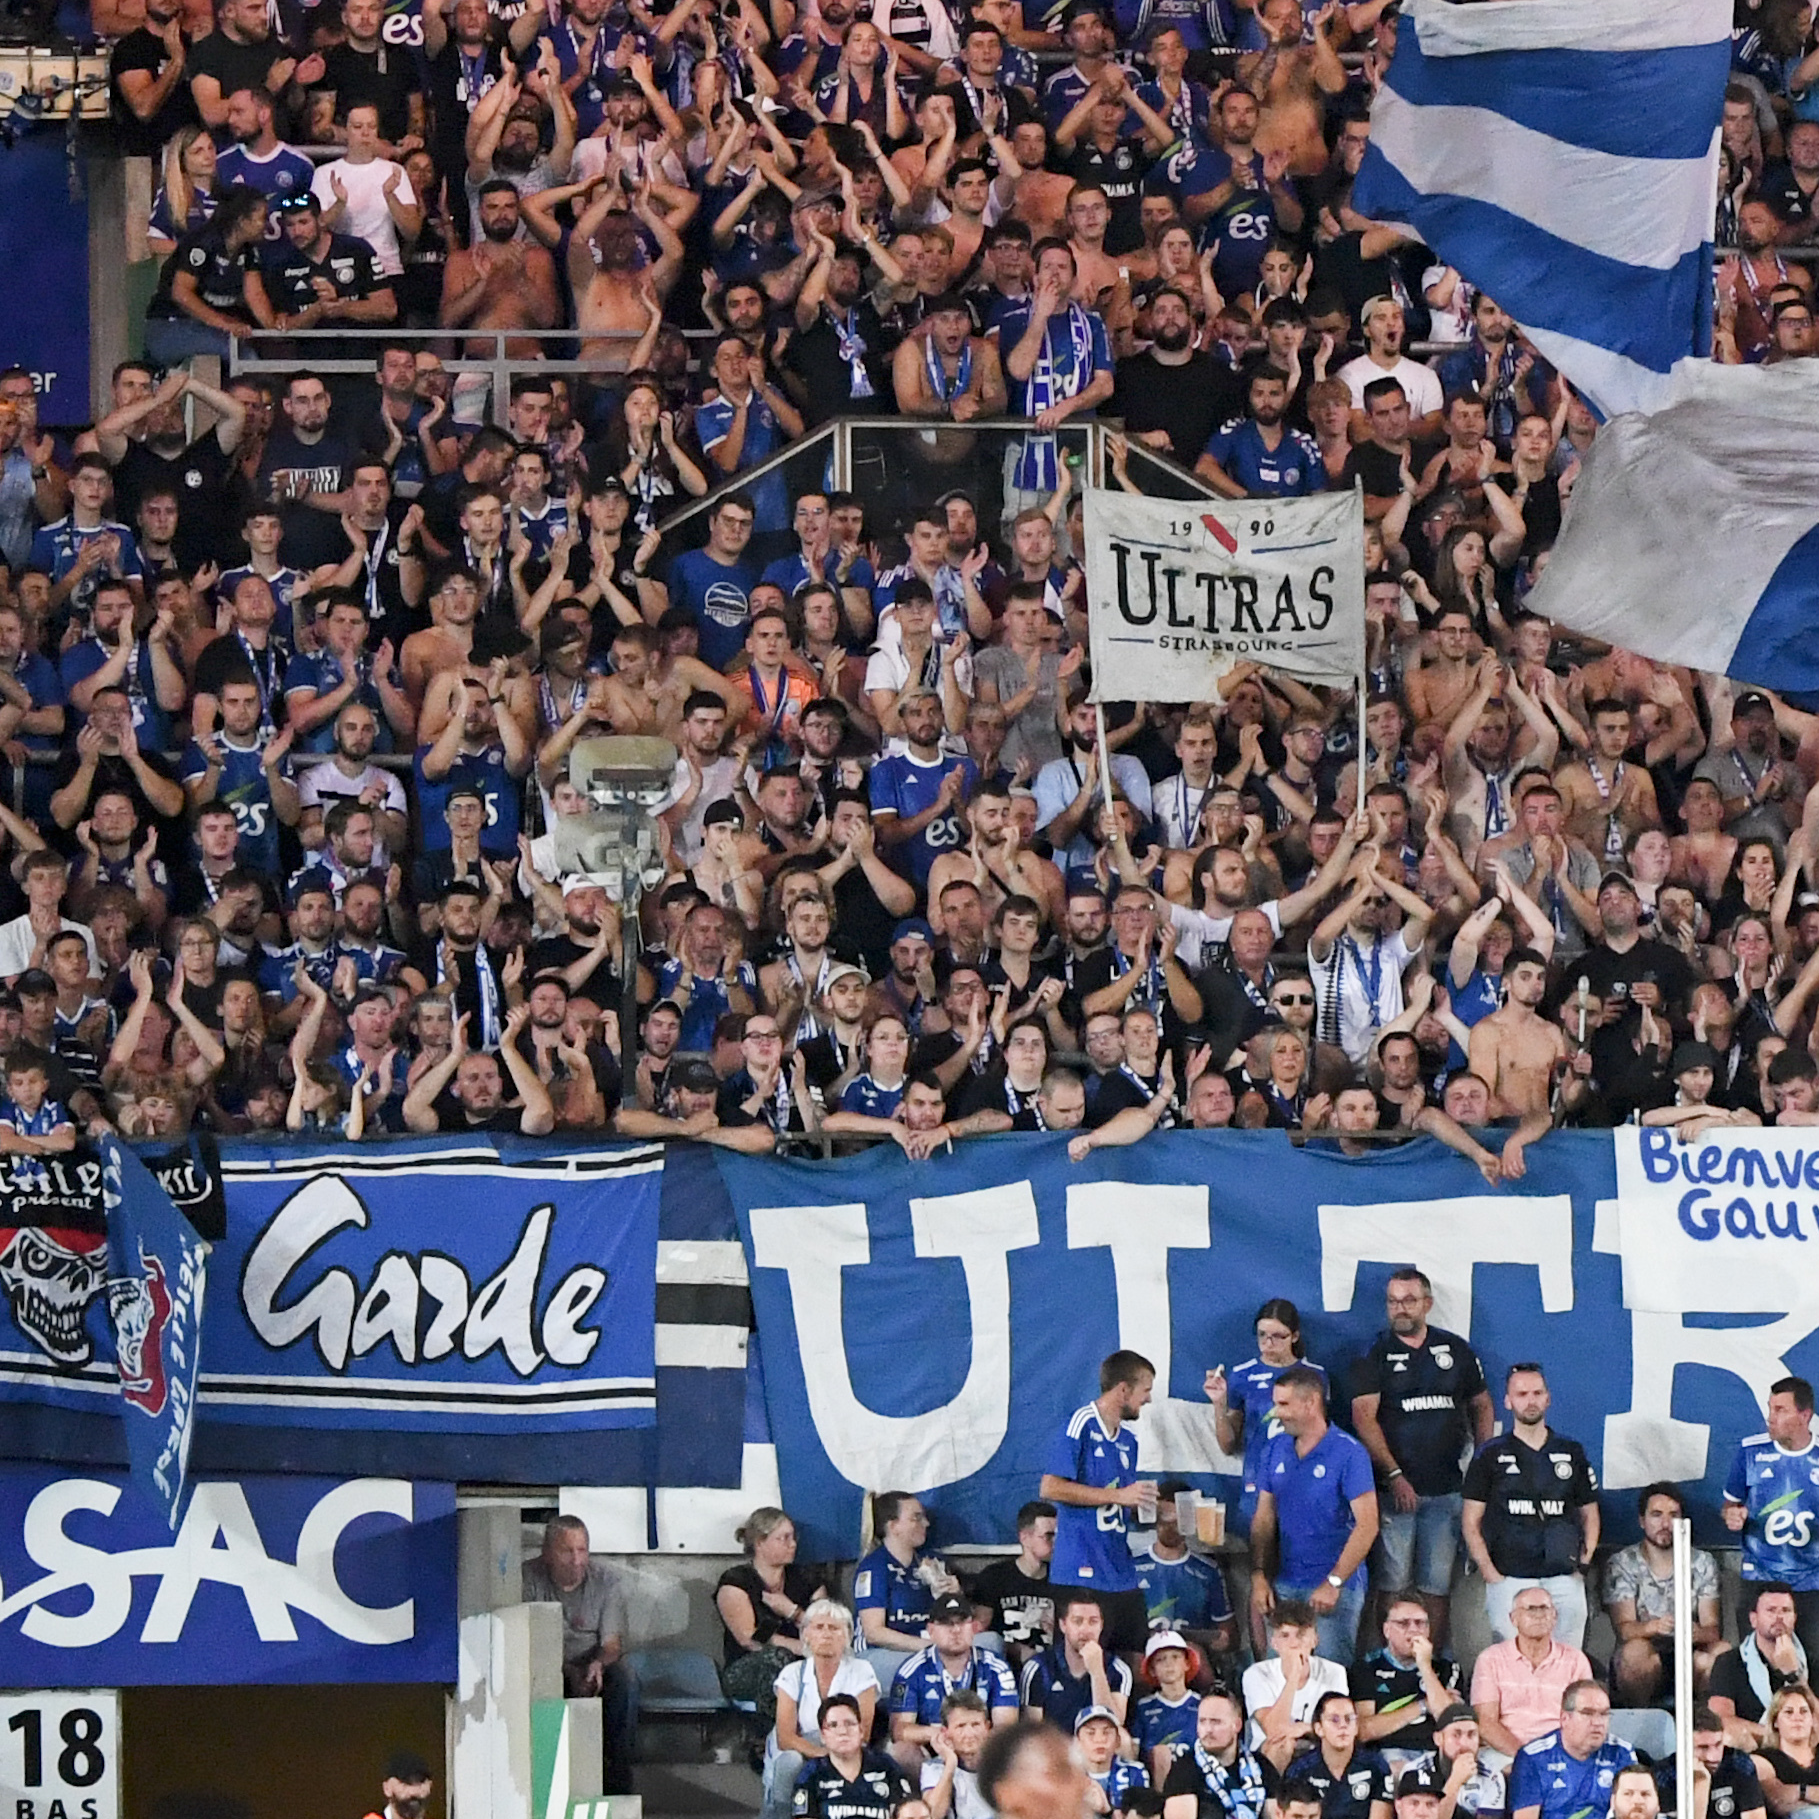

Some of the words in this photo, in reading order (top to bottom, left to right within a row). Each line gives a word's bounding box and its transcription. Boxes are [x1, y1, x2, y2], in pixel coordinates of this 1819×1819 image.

[384, 11, 424, 44] es
[1229, 209, 1268, 241] es
[1169, 520, 1193, 537] 19
[1249, 519, 1276, 538] 90
[1158, 634, 1294, 654] STRASBOURG
[926, 818, 960, 847] es
[242, 1173, 608, 1378] Garde
[1402, 1397, 1454, 1411] WINAMAX
[1764, 1511, 1814, 1547] es
[0, 1478, 415, 1648] SAC
[7, 1707, 107, 1789] 18
